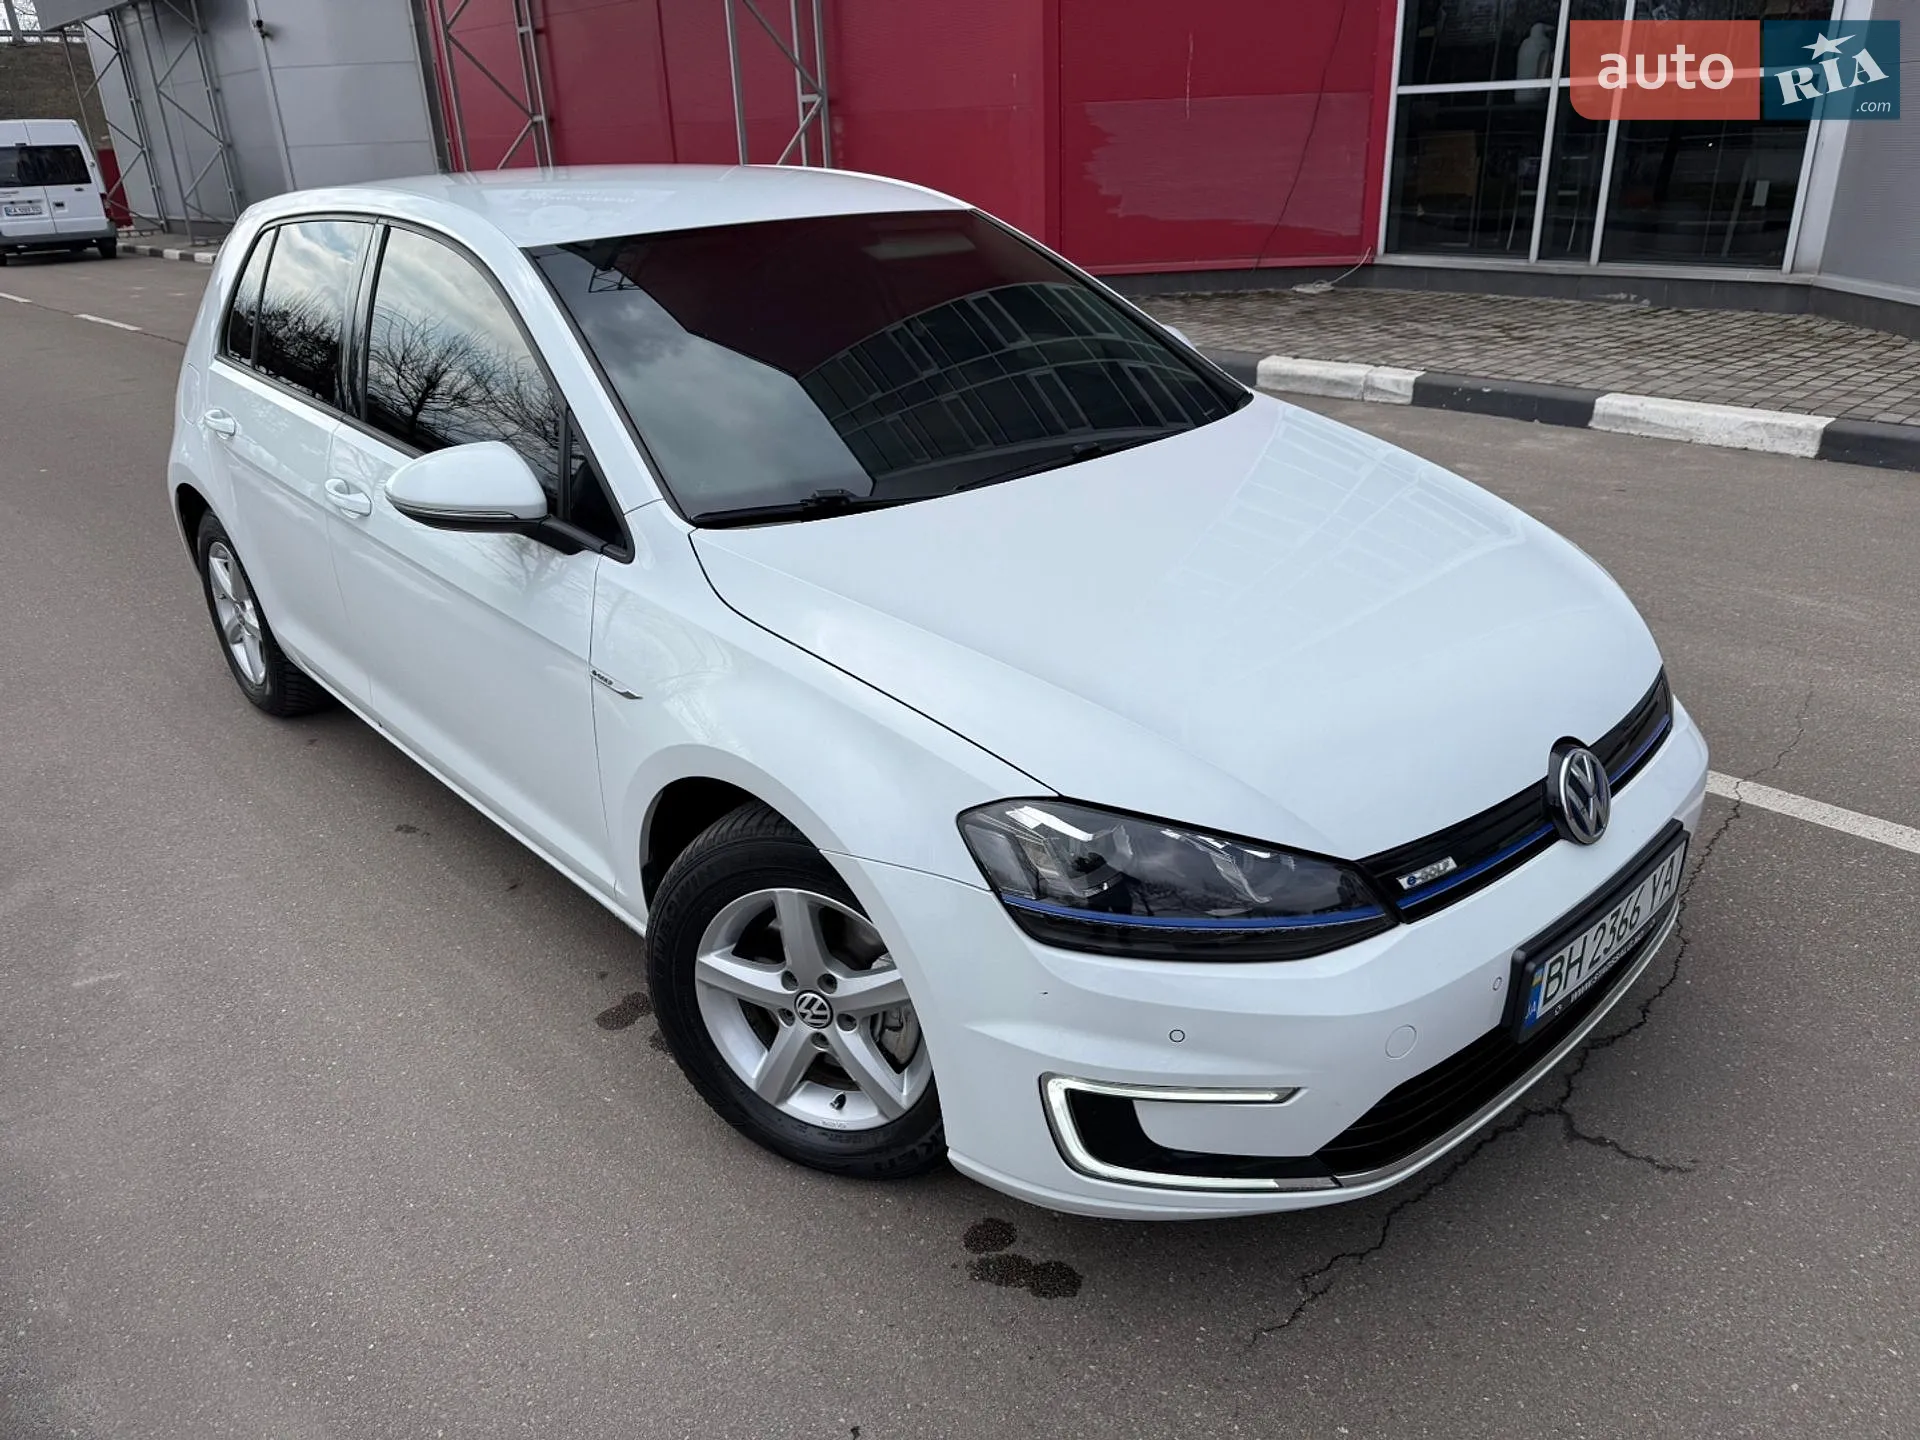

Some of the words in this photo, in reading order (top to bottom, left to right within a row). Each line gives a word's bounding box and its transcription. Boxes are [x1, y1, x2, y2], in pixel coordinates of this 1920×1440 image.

[1543, 934, 1588, 1006] BH
[1588, 884, 1645, 971] 2366
[1649, 854, 1675, 912] YA
